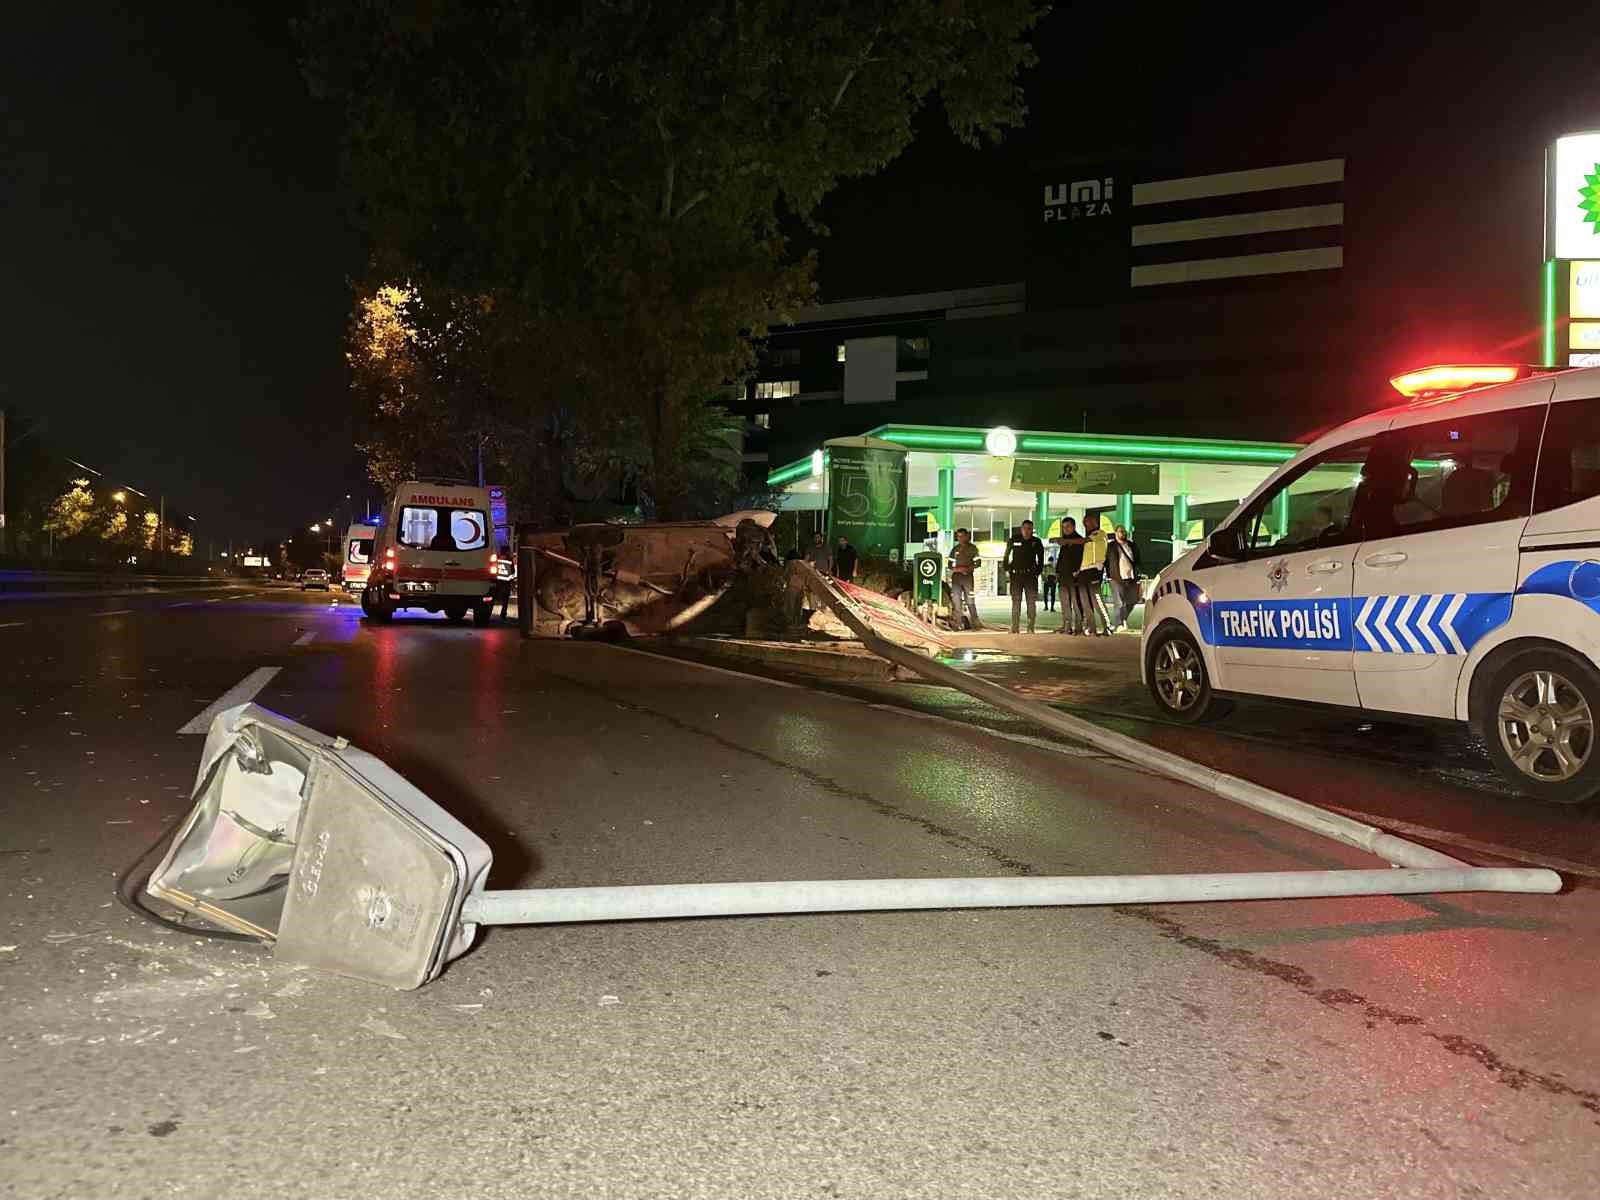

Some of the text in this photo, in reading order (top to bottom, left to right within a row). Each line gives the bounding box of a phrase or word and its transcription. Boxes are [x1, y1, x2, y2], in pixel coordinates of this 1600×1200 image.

[1044, 202, 1112, 222] PLAZA
[410, 495, 475, 507] AMBULANS
[1220, 602, 1341, 640] TRAFİK POLİSİ
